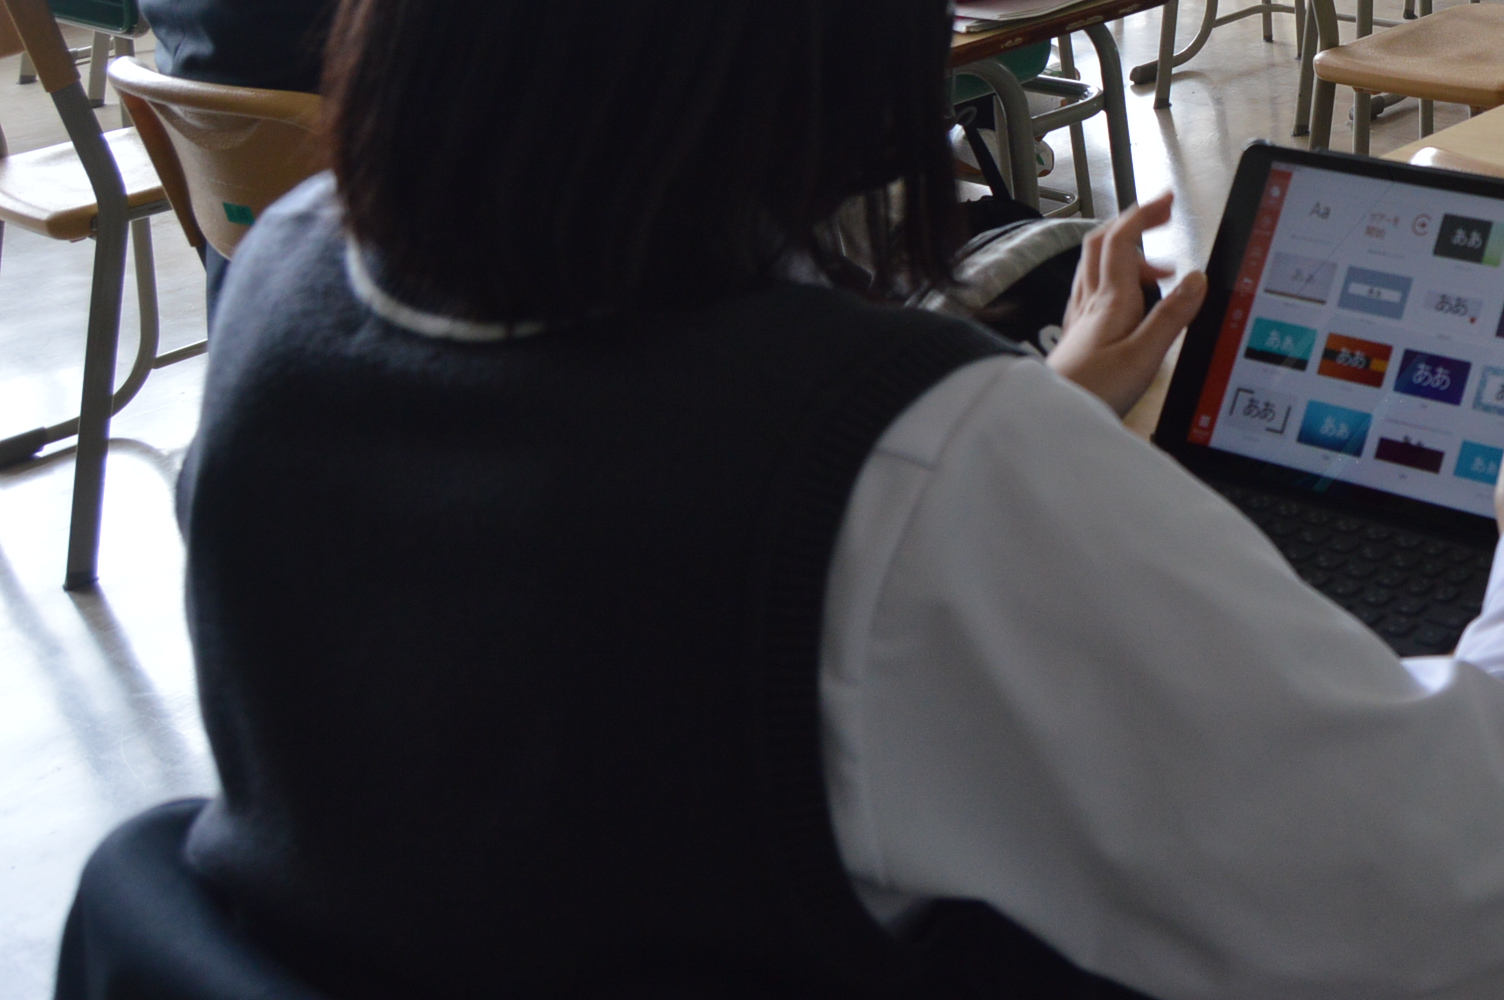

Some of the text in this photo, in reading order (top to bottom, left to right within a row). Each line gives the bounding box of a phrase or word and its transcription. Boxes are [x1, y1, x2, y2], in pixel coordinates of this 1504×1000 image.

[1452, 227, 1483, 250] ああ
[1434, 294, 1468, 317] ああ
[1412, 362, 1451, 391] ああ
